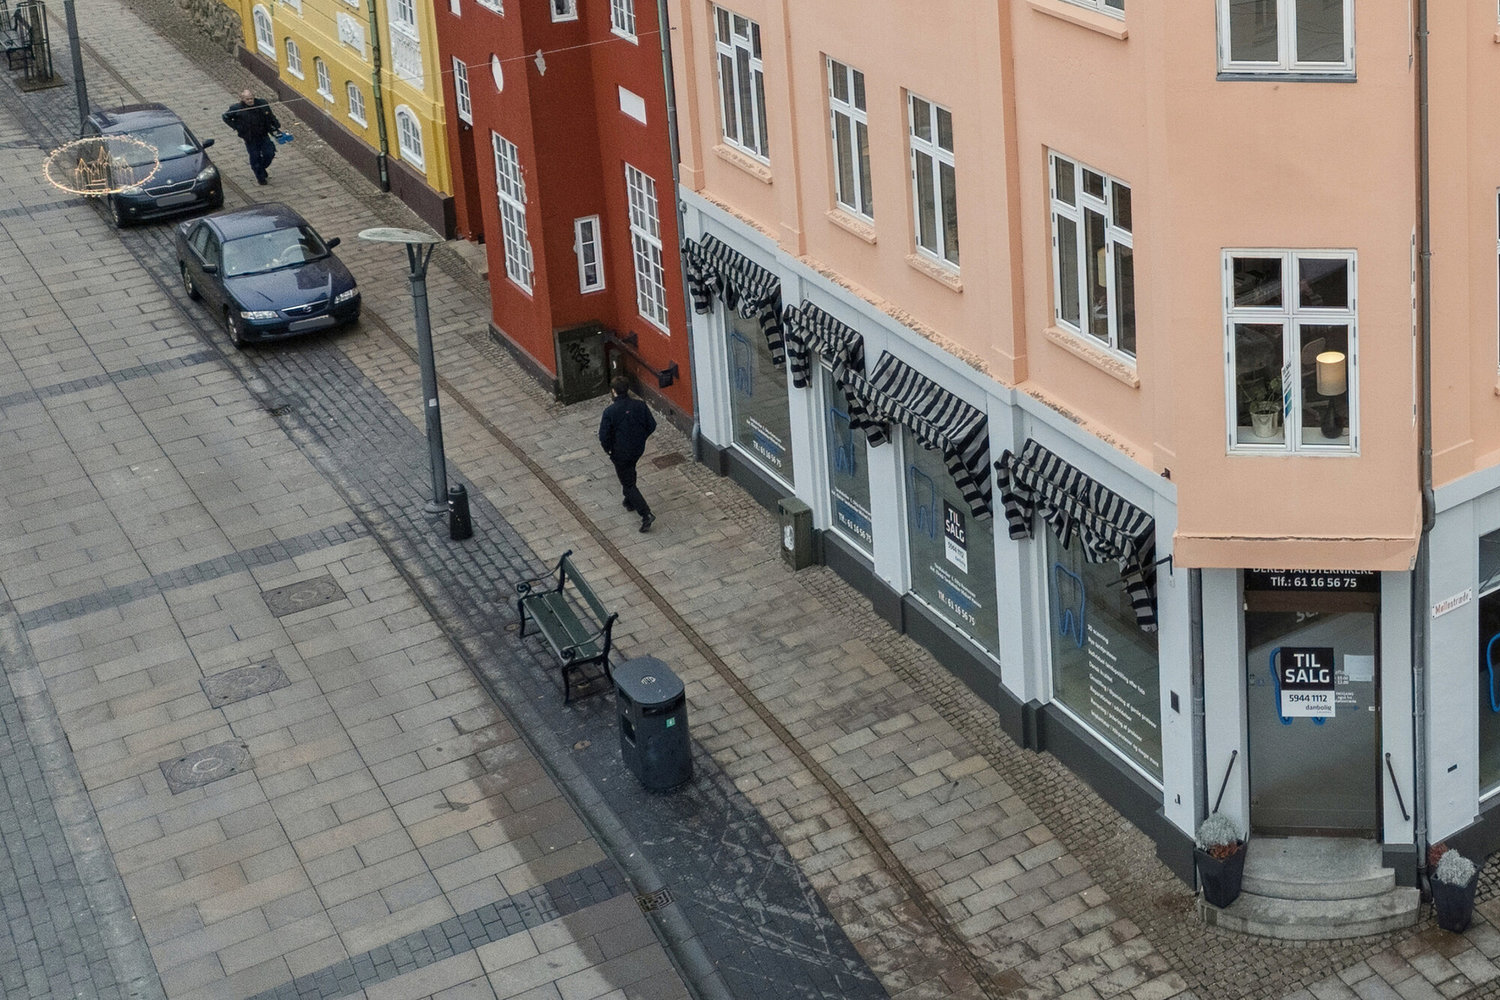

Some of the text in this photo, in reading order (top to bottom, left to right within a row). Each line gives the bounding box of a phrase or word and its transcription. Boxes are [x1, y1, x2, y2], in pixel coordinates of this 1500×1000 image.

[948, 508, 960, 527] TIL
[945, 519, 965, 543] SALG
[1271, 577, 1357, 588] Tlf.: 61 16 56 75
[948, 598, 954, 610] 61
[955, 604, 961, 615] 16
[962, 609, 968, 620] 56
[969, 614, 975, 626] 75
[1294, 654, 1320, 667] TIL
[1285, 669, 1330, 683] SALG
[1289, 694, 1327, 702] 5944 1112
